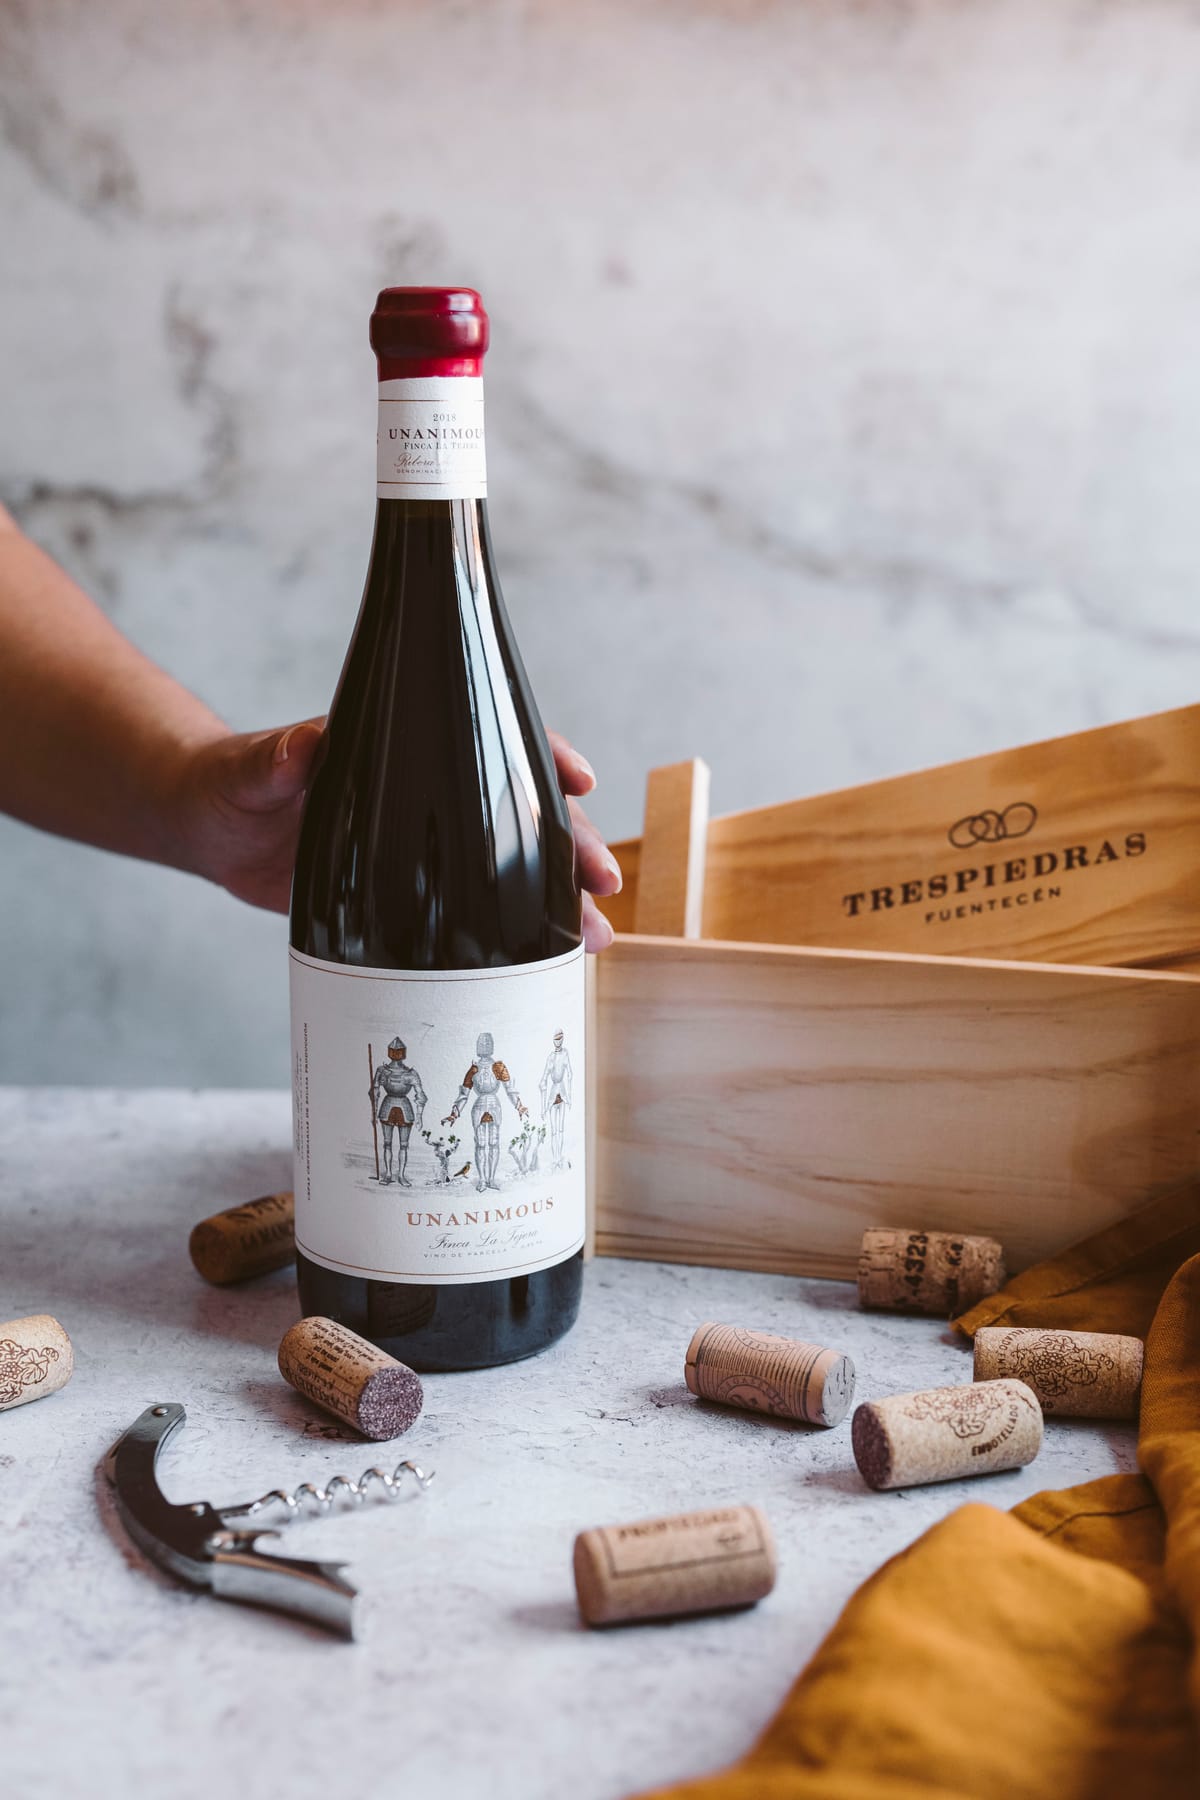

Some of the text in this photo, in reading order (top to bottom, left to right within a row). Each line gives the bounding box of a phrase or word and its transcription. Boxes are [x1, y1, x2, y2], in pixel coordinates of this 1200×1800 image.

[433, 413, 457, 422] 2018
[389, 428, 483, 440] UNANIMOU
[404, 442, 432, 450] FINCA
[842, 832, 1147, 917] TRESPIEDRAS
[925, 886, 1061, 924] FUENTECÉN
[407, 1197, 554, 1227] UNANIMOUS
[428, 1232, 471, 1250] Finca
[475, 1231, 498, 1248] La
